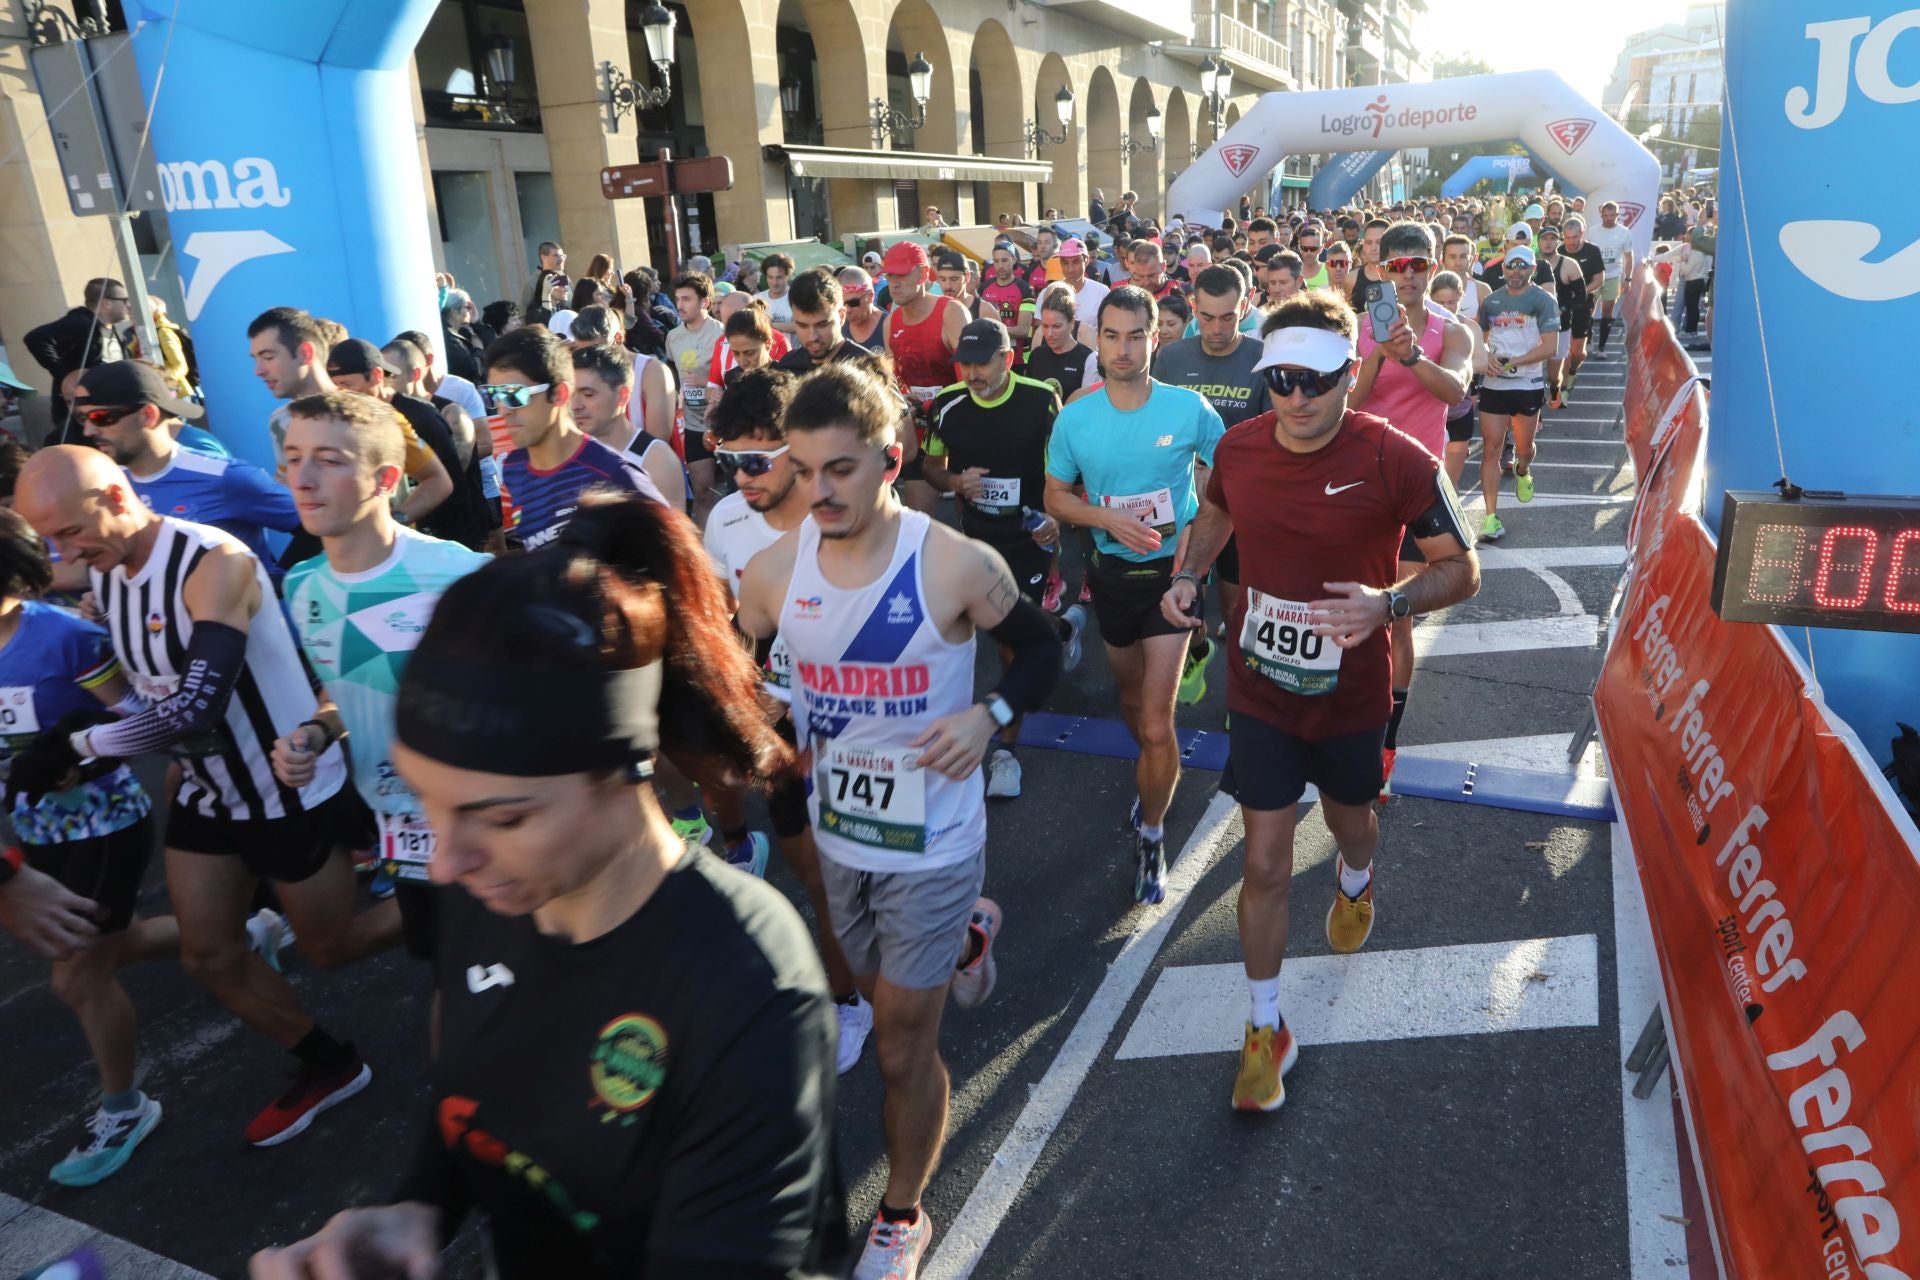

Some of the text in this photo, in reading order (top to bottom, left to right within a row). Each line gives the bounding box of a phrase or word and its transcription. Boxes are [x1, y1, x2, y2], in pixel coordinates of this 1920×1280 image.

[1398, 102, 1478, 129] deporte
[1264, 604, 1274, 619] LA
[1257, 620, 1323, 661] 490
[1272, 654, 1301, 666] ADOLFO
[1633, 594, 1683, 695] ferrer
[156, 659, 208, 718] CYCLING
[797, 659, 930, 698] MADRID
[884, 697, 928, 717] RUN
[1669, 678, 1735, 813] ferrer
[831, 766, 895, 811] 747
[1716, 804, 1807, 993] ferrer
[1715, 914, 1753, 1009] sport center
[1766, 1010, 1913, 1280] ferre
